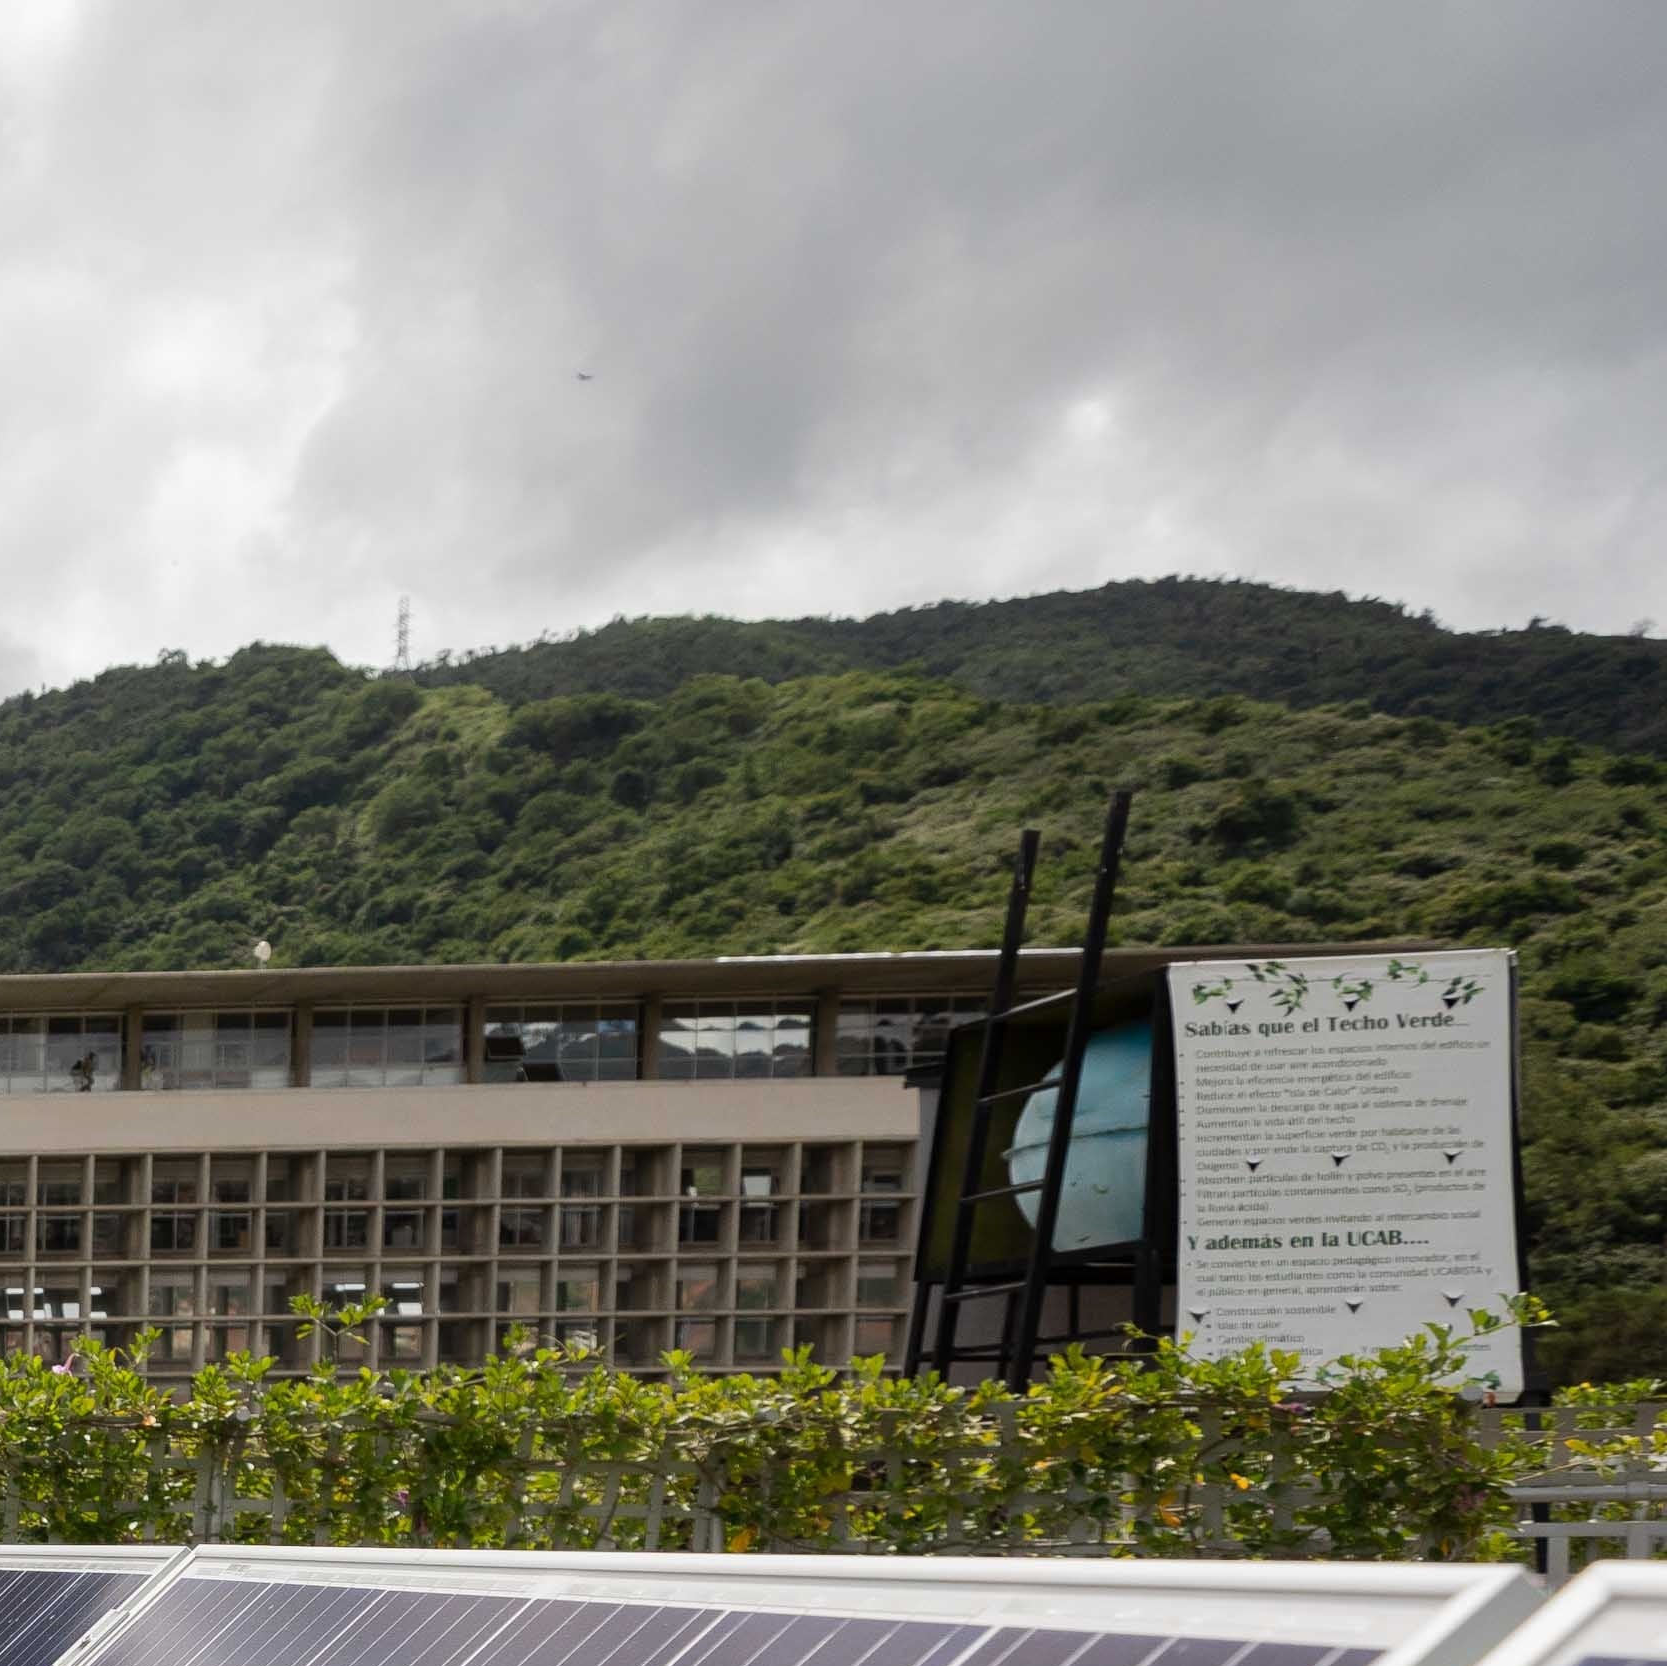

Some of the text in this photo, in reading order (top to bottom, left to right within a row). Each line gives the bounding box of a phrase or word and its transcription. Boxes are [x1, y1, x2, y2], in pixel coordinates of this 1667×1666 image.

[1258, 1020, 1295, 1038] que
[1302, 1018, 1319, 1033] el
[1327, 1015, 1389, 1032] Techo
[1187, 1235, 1199, 1250] Y
[1205, 1233, 1284, 1250] además
[1290, 1236, 1314, 1249] en
[1322, 1232, 1339, 1248] la
